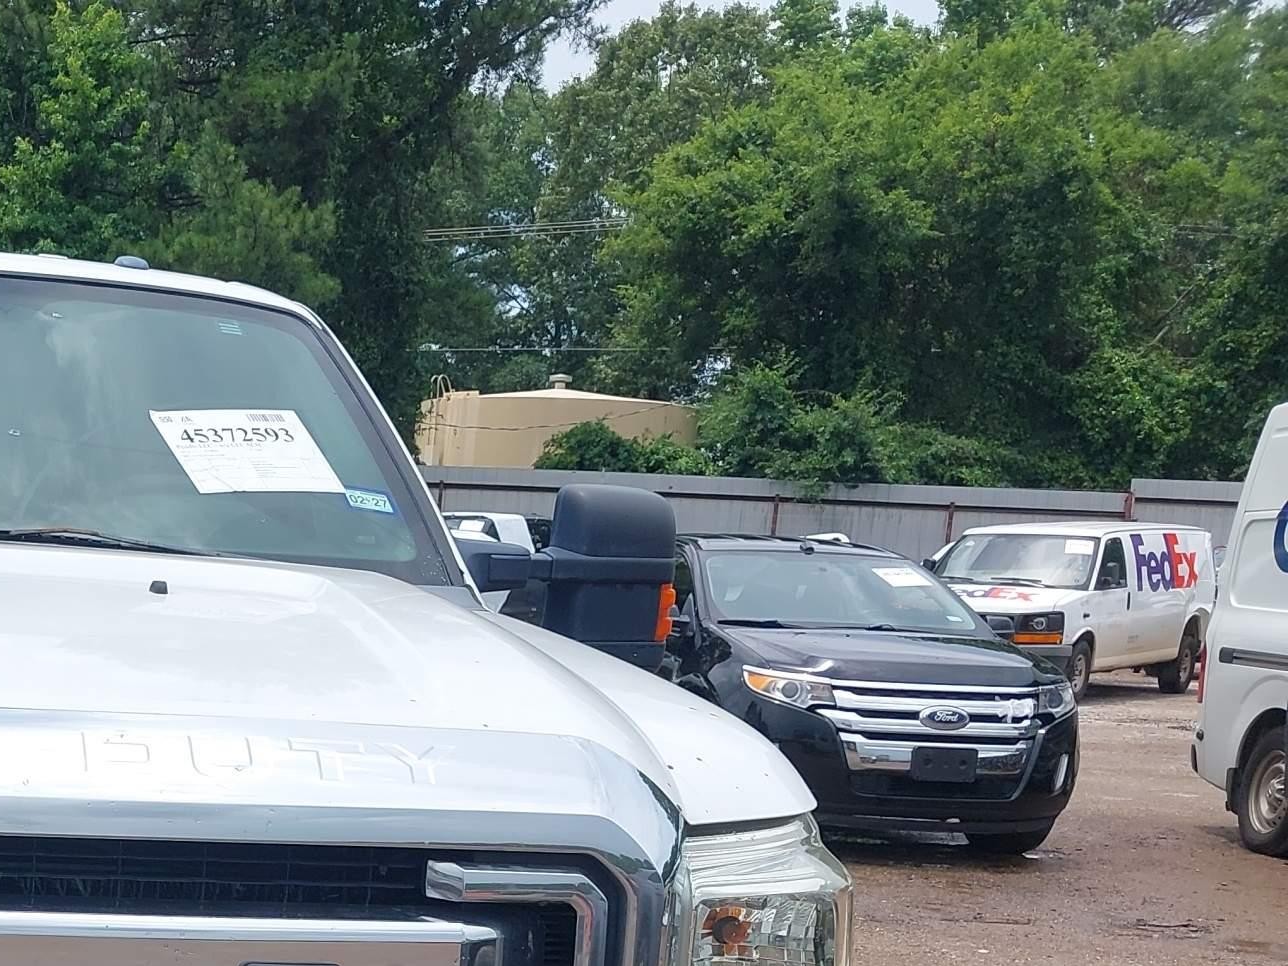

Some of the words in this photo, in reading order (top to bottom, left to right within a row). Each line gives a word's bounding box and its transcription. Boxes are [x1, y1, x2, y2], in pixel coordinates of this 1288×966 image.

[180, 427, 295, 443] 45372593
[1129, 532, 1199, 592] FedEx
[934, 710, 960, 722] Ford
[79, 730, 457, 786] DUTY
